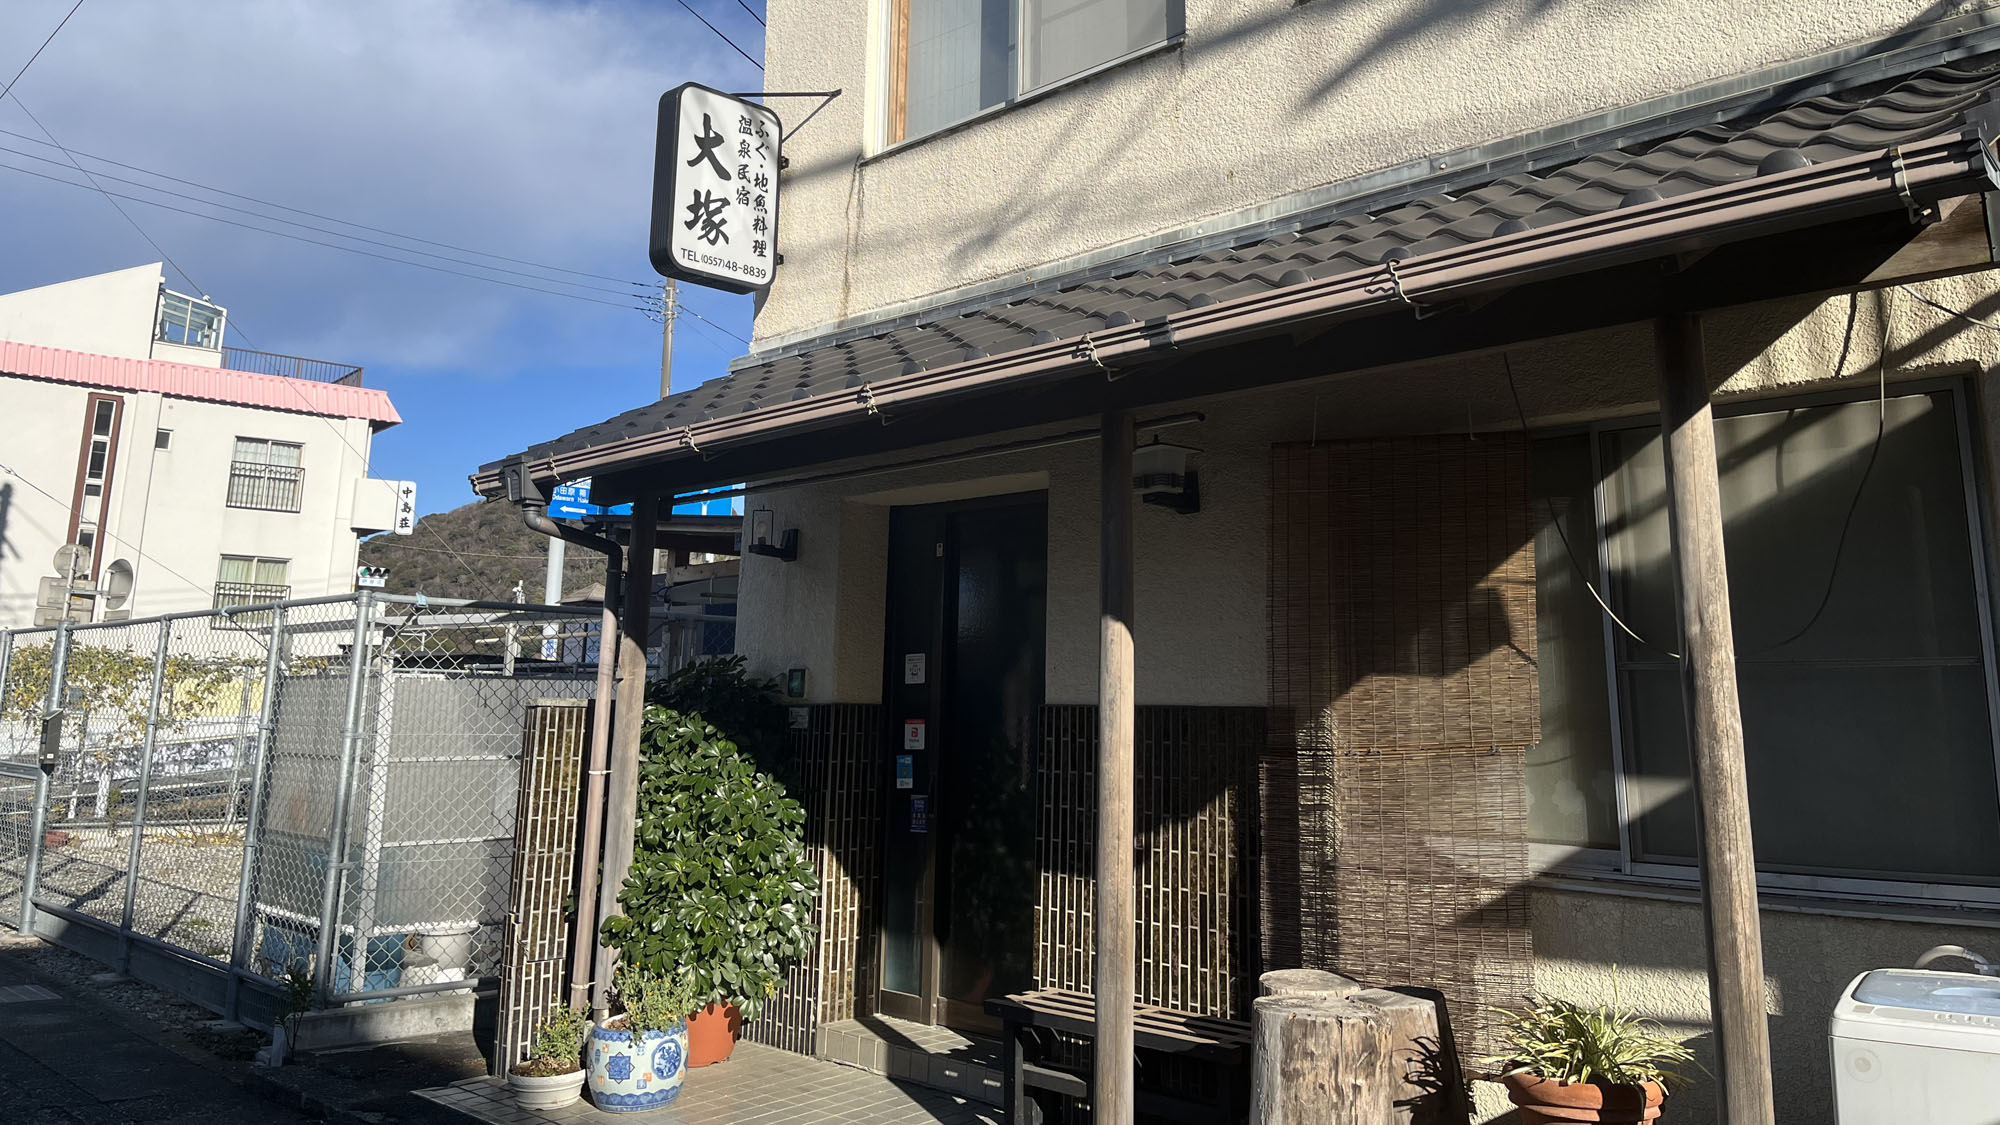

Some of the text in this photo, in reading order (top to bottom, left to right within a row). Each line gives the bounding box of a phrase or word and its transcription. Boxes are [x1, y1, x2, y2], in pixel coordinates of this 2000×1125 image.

[684, 112, 731, 246] 大塚
[736, 115, 752, 206] 温泉民宿
[752, 120, 769, 258] ふぐ・地魚料理
[680, 247, 767, 279] TEL (0557)48-8839
[399, 487, 413, 529] 中島荘
